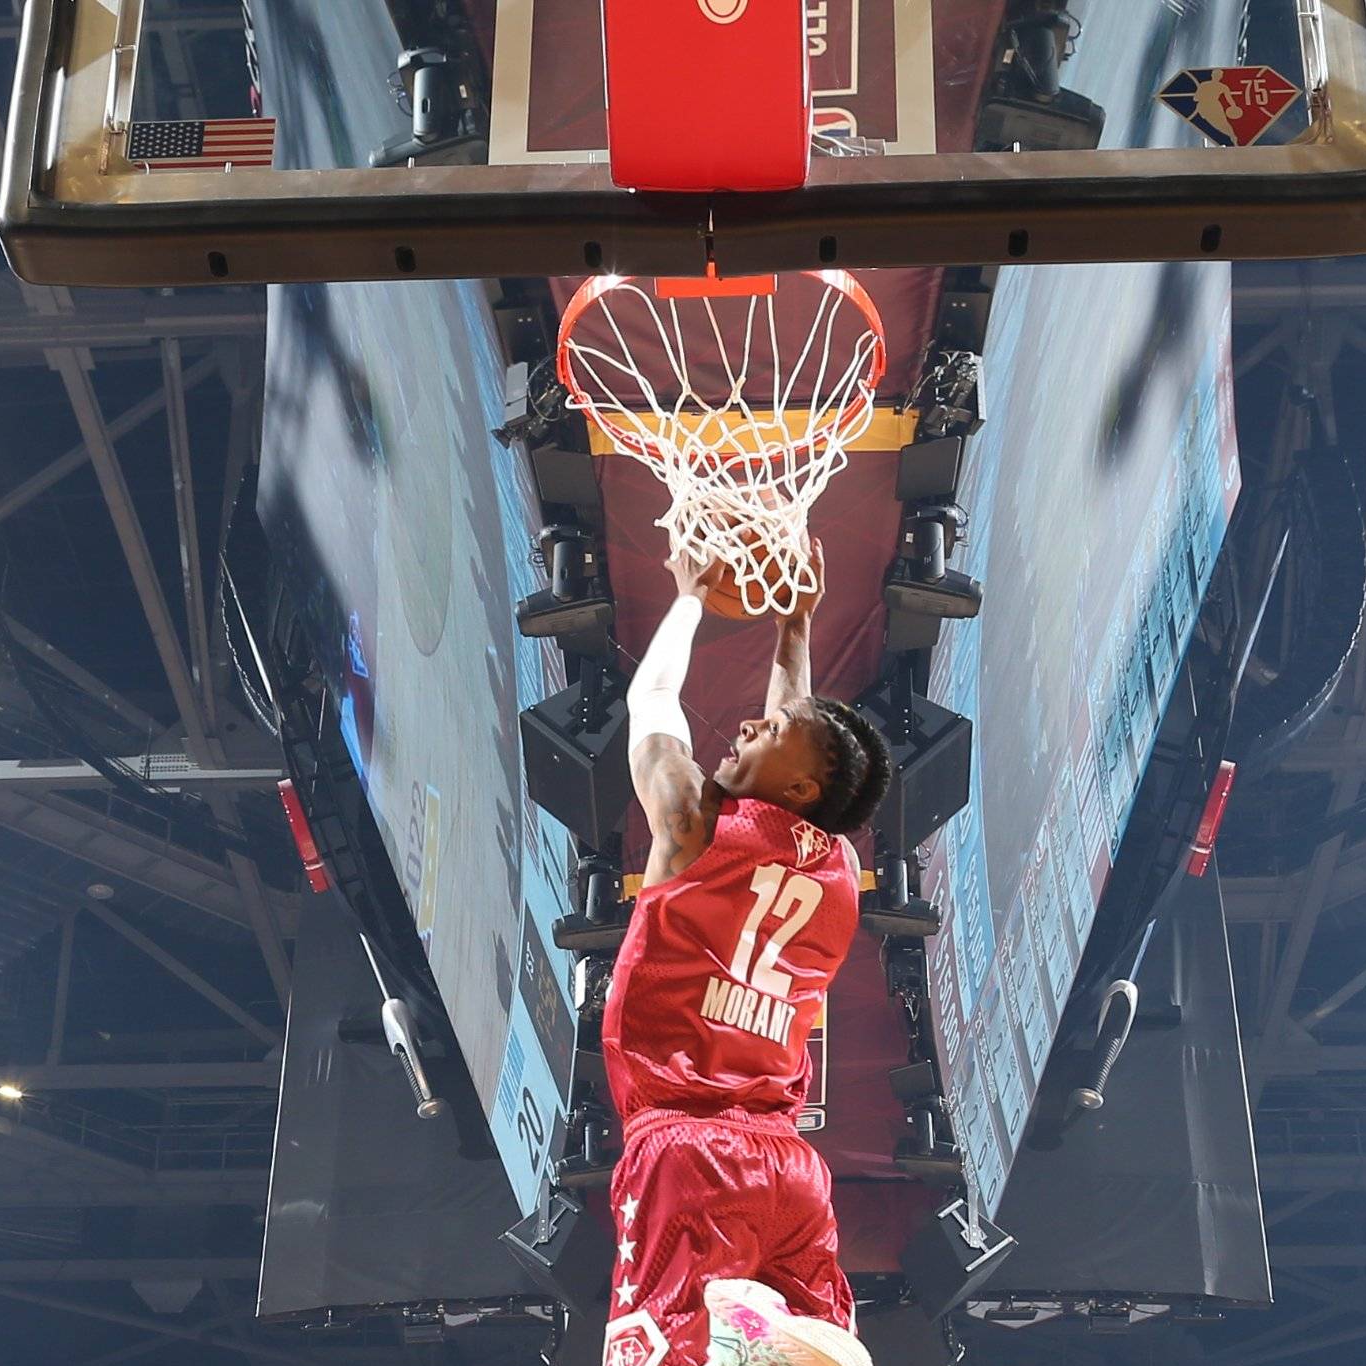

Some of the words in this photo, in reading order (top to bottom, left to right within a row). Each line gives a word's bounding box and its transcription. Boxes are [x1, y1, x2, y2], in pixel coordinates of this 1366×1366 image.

[1240, 79, 1269, 106] 75
[730, 862, 824, 998] 12
[700, 976, 797, 1047] MORANT
[518, 1086, 544, 1178] 20
